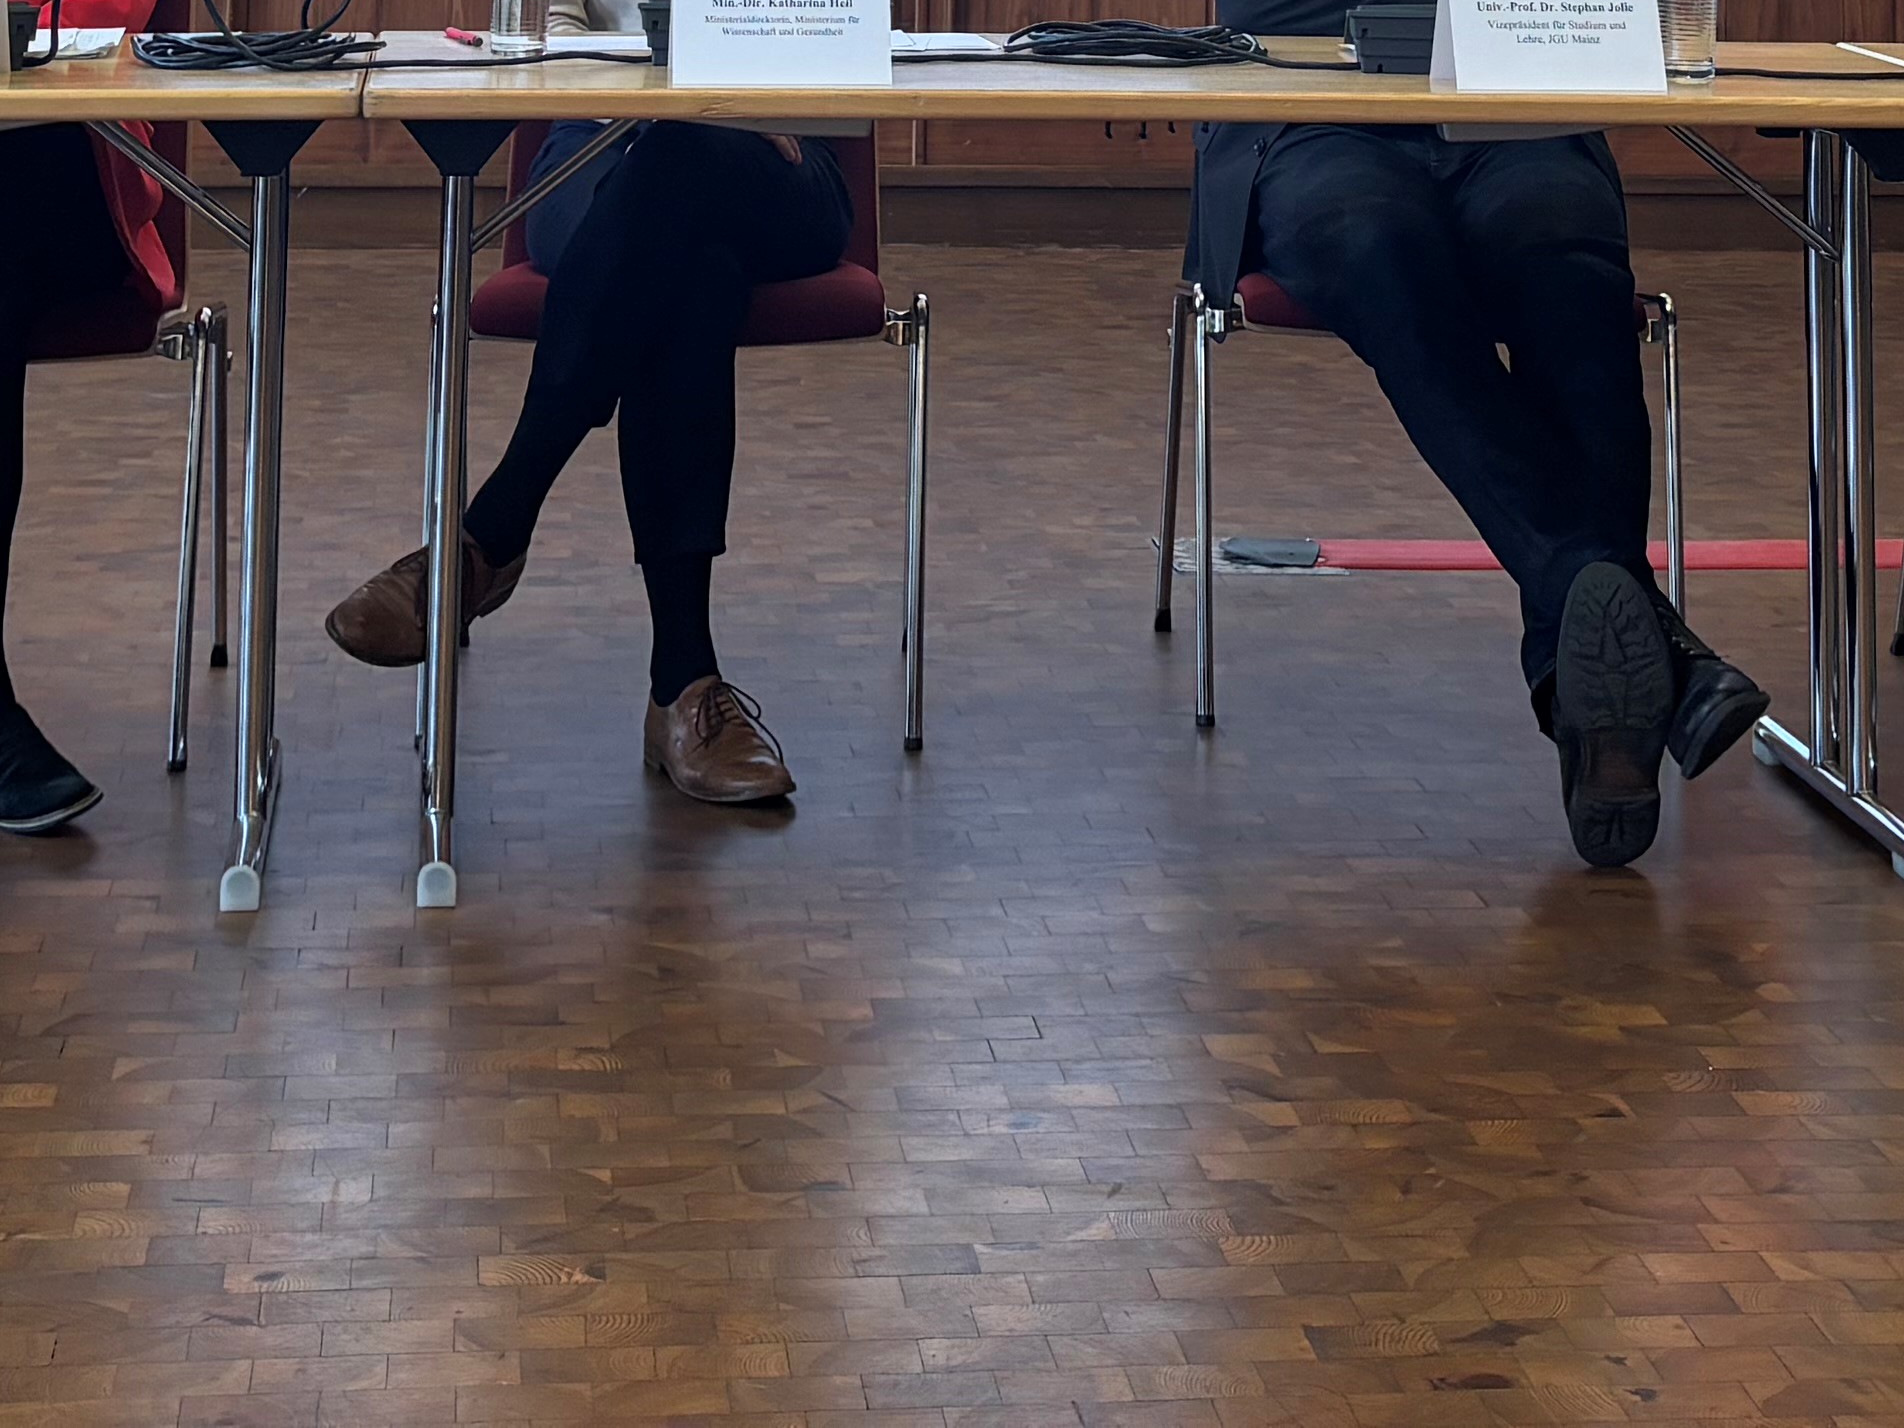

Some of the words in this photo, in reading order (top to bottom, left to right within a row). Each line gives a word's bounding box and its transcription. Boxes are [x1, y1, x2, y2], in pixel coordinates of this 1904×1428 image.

[1476, 1, 1538, 13] Univ.-Prof.
[1540, 1, 1559, 13] Dr.
[1560, 1, 1606, 15] Stephan
